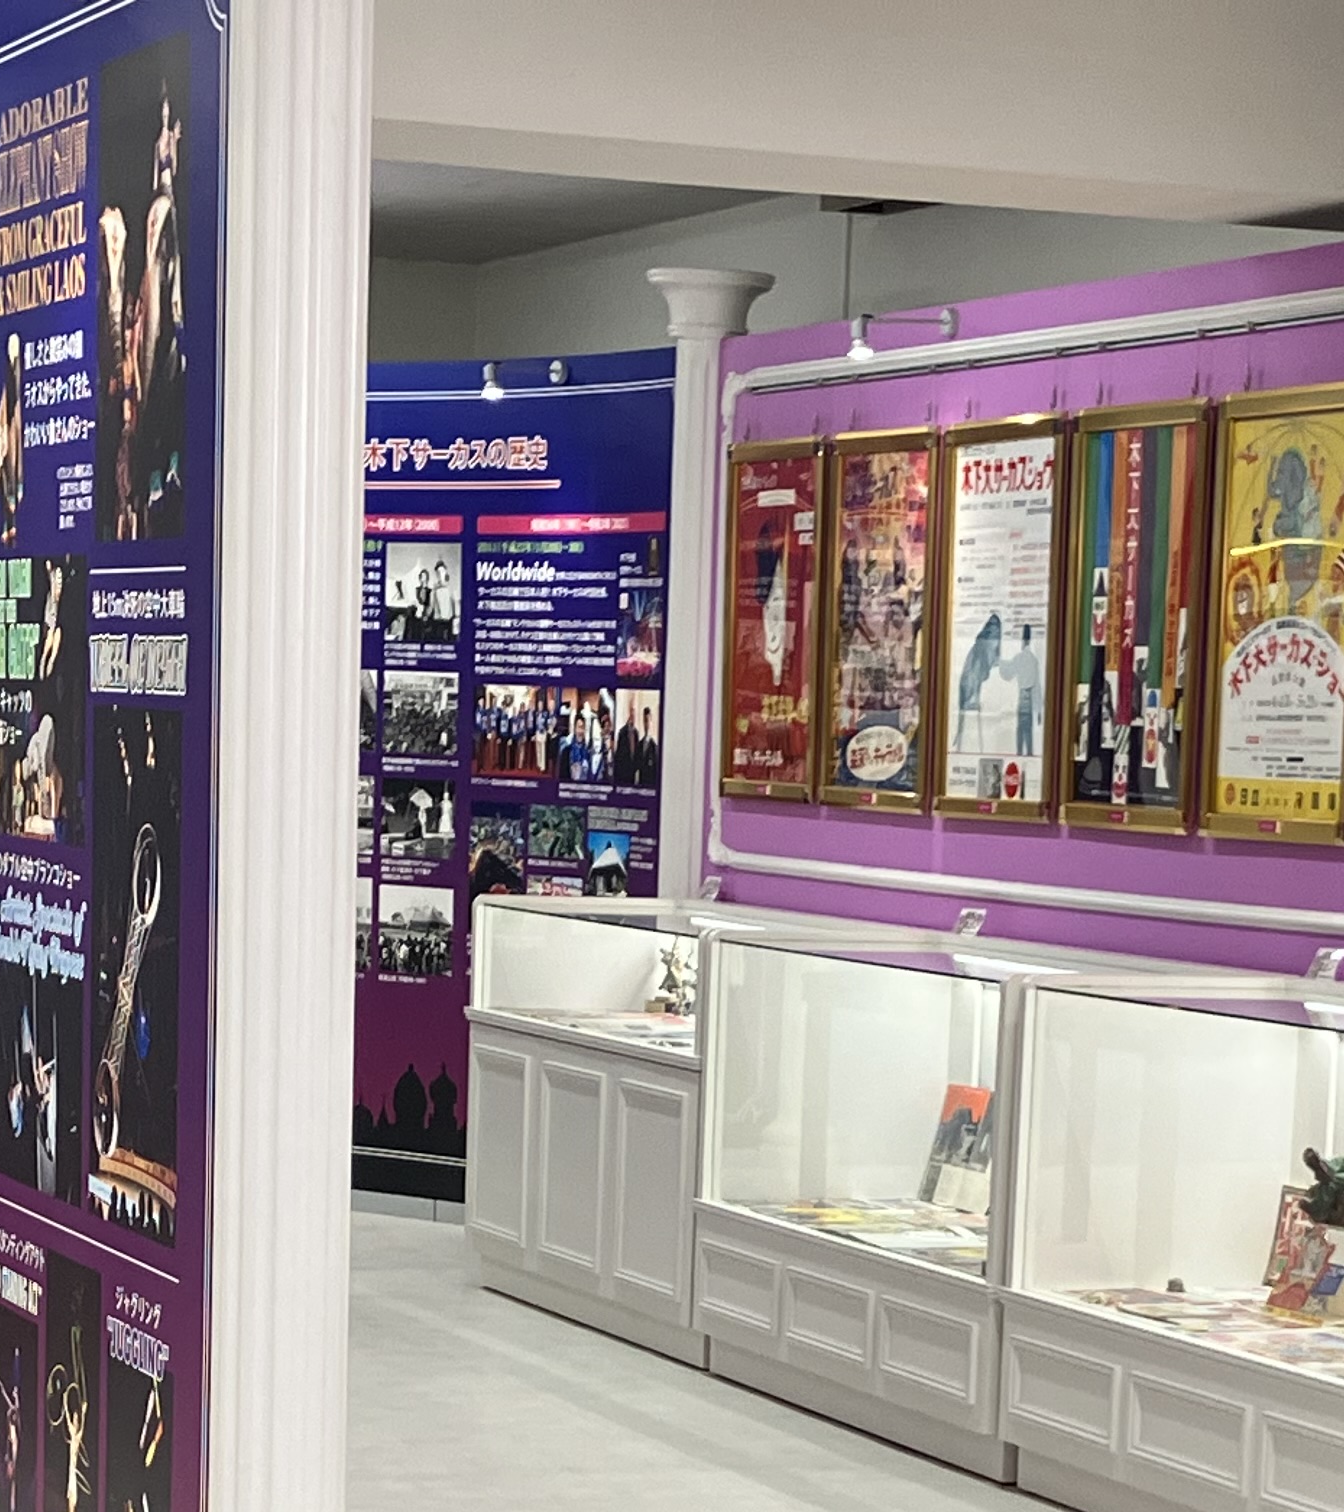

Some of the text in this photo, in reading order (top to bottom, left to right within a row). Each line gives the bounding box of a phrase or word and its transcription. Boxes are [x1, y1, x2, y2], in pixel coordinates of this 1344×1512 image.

[28, 200, 87, 260] GRACEFUL
[6, 260, 52, 315] SMILING
[54, 253, 86, 304] LAOS
[362, 435, 549, 472] 木下サーカスの歴史
[476, 560, 557, 583] Worldwide
[114, 1284, 163, 1332] ジャグリング
